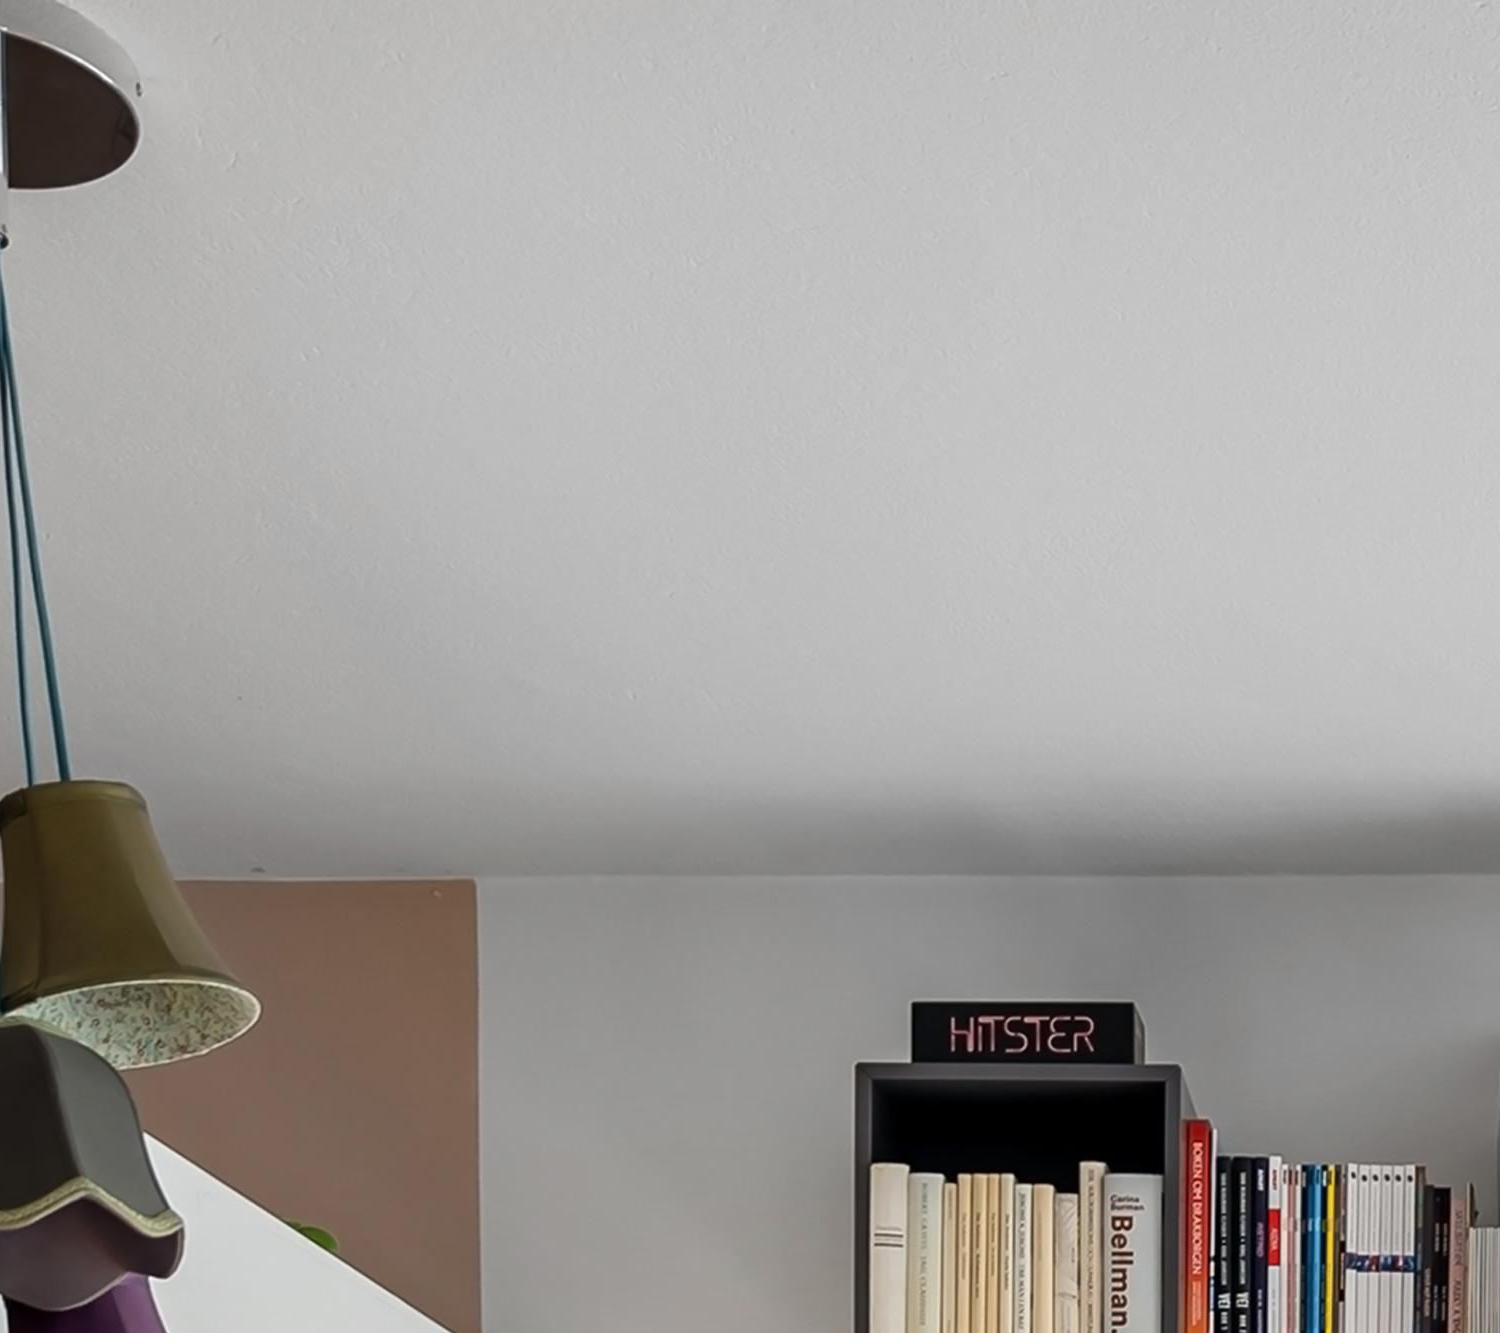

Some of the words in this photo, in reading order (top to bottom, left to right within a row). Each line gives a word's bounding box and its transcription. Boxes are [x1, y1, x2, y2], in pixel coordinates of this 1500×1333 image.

[950, 1016, 1094, 1053] HITSTER
[1191, 1141, 1204, 1182] BOKEN
[1110, 1194, 1140, 1203] Carina
[1191, 1183, 1203, 1200] OM
[1190, 1202, 1203, 1276] DRAKBORGEN
[1256, 1222, 1265, 1258] ASTRID
